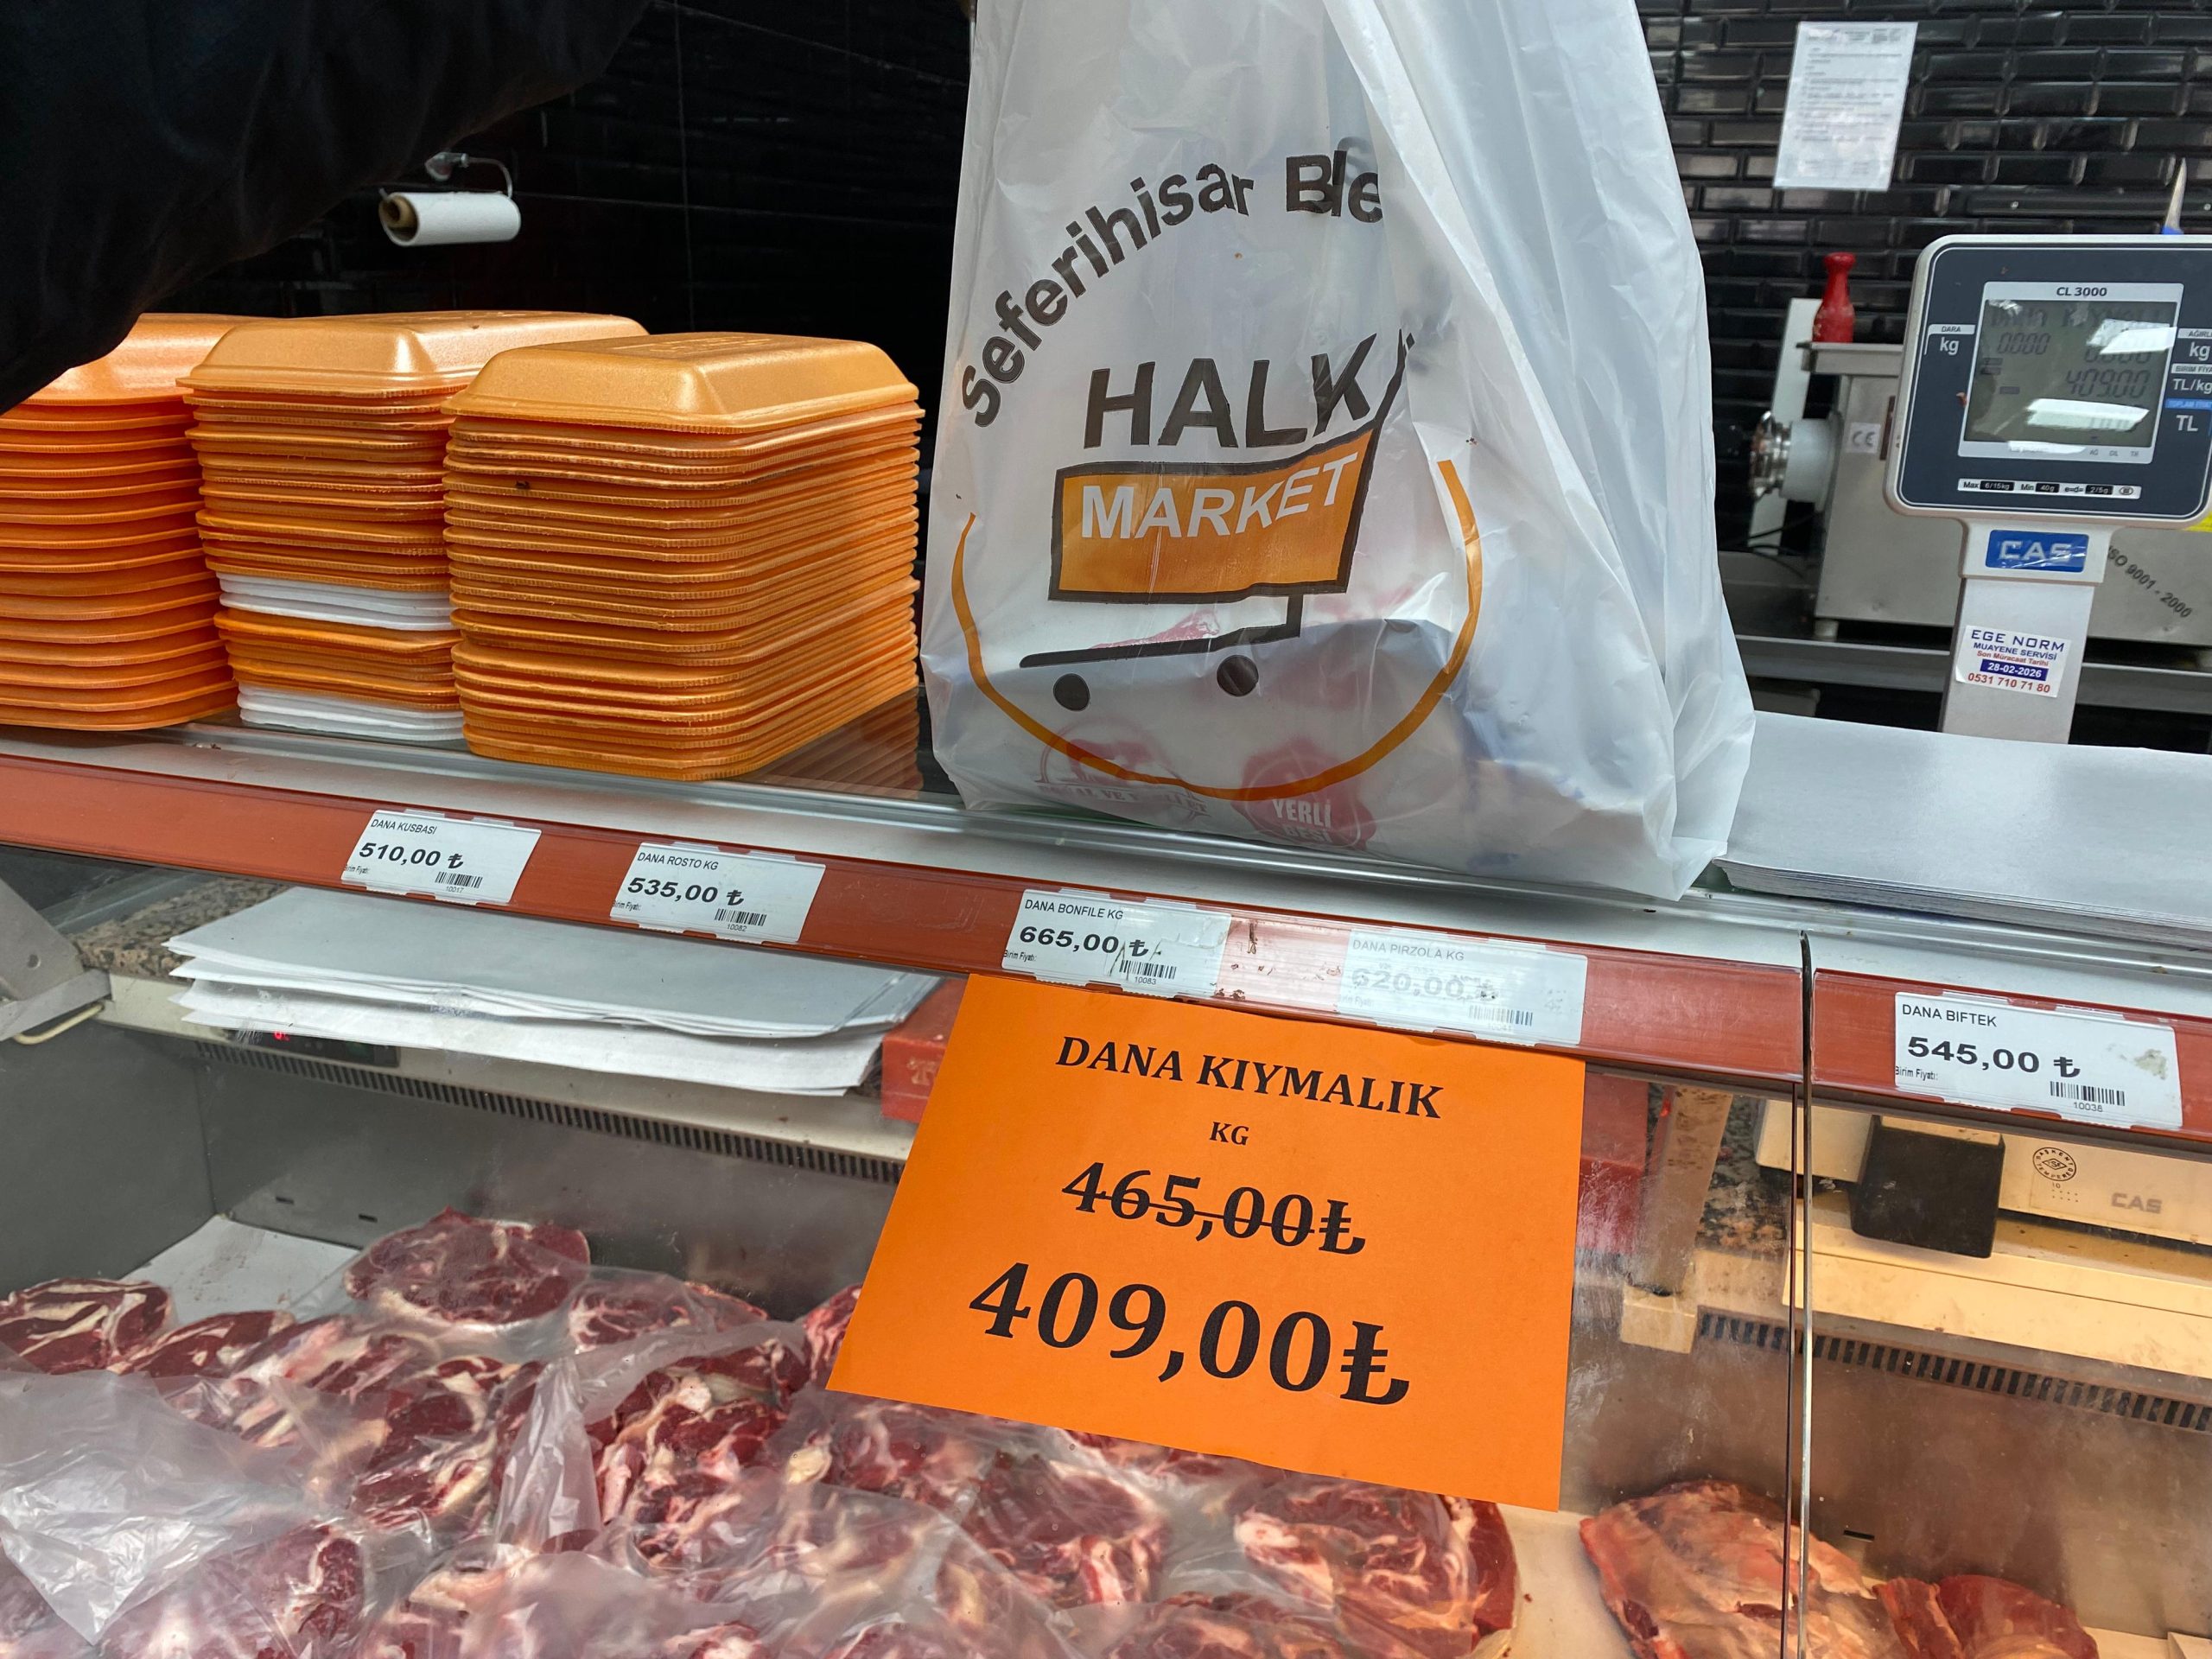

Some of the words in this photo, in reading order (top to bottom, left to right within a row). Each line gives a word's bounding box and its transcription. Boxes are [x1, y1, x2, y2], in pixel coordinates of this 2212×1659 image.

[962, 163, 1254, 426] Seferihisar
[1940, 336, 1960, 355] kg
[2189, 341, 2211, 361] kg
[1084, 332, 1377, 449] HALK
[2173, 378, 2212, 394] TL/kg
[2177, 415, 2198, 431] TL
[1080, 453, 1358, 539] MARKET
[1999, 541, 2072, 562] CAS
[2125, 563, 2157, 591] 9001
[2159, 591, 2193, 618] 2000
[1972, 630, 2005, 643] EGE
[2012, 635, 2064, 652] NORM
[1974, 643, 2018, 654] MUAYENE
[2020, 649, 2056, 660] SERVİSİ
[1987, 663, 2042, 677] 28-02-2026
[1993, 652, 2026, 663] Müracaat
[2028, 658, 2049, 666] Tarihi
[1968, 673, 1993, 683] 0531
[1998, 677, 2018, 688] 710
[2021, 681, 2033, 690] 71
[2037, 683, 2050, 693] 80
[1272, 798, 1332, 830] YERLİ
[371, 818, 397, 831] DANA
[398, 822, 437, 835] KUSBASI
[359, 842, 441, 866] 510,00
[448, 853, 464, 869] ₺
[637, 852, 664, 864] DANA
[666, 856, 702, 869] ROSTO
[703, 861, 719, 871] KG
[627, 877, 718, 903] 535,00
[727, 890, 744, 906] ₺
[1025, 899, 1054, 912] DANA
[1058, 903, 1105, 918] BONFILE
[1107, 910, 1124, 920] KG
[1020, 926, 1119, 953] 665,00
[1129, 939, 1149, 957] ₺
[1352, 939, 1387, 953] DANA
[1390, 944, 1442, 958] PIRZOLA
[1446, 950, 1465, 962] KG
[1135, 976, 1157, 985] 10083
[1351, 968, 1465, 997] 620,00
[1903, 1004, 1942, 1020] DANA
[1946, 1011, 1998, 1027] BIFTEK
[1908, 1036, 2039, 1072] 545,00
[2053, 1056, 2081, 1078] ₺
[1056, 1035, 1184, 1082] DANA
[1196, 1054, 1446, 1120] KIYMALIK
[2074, 1102, 2103, 1113] 10038
[1210, 1121, 1250, 1147] KG
[2112, 1192, 2163, 1214] CAS
